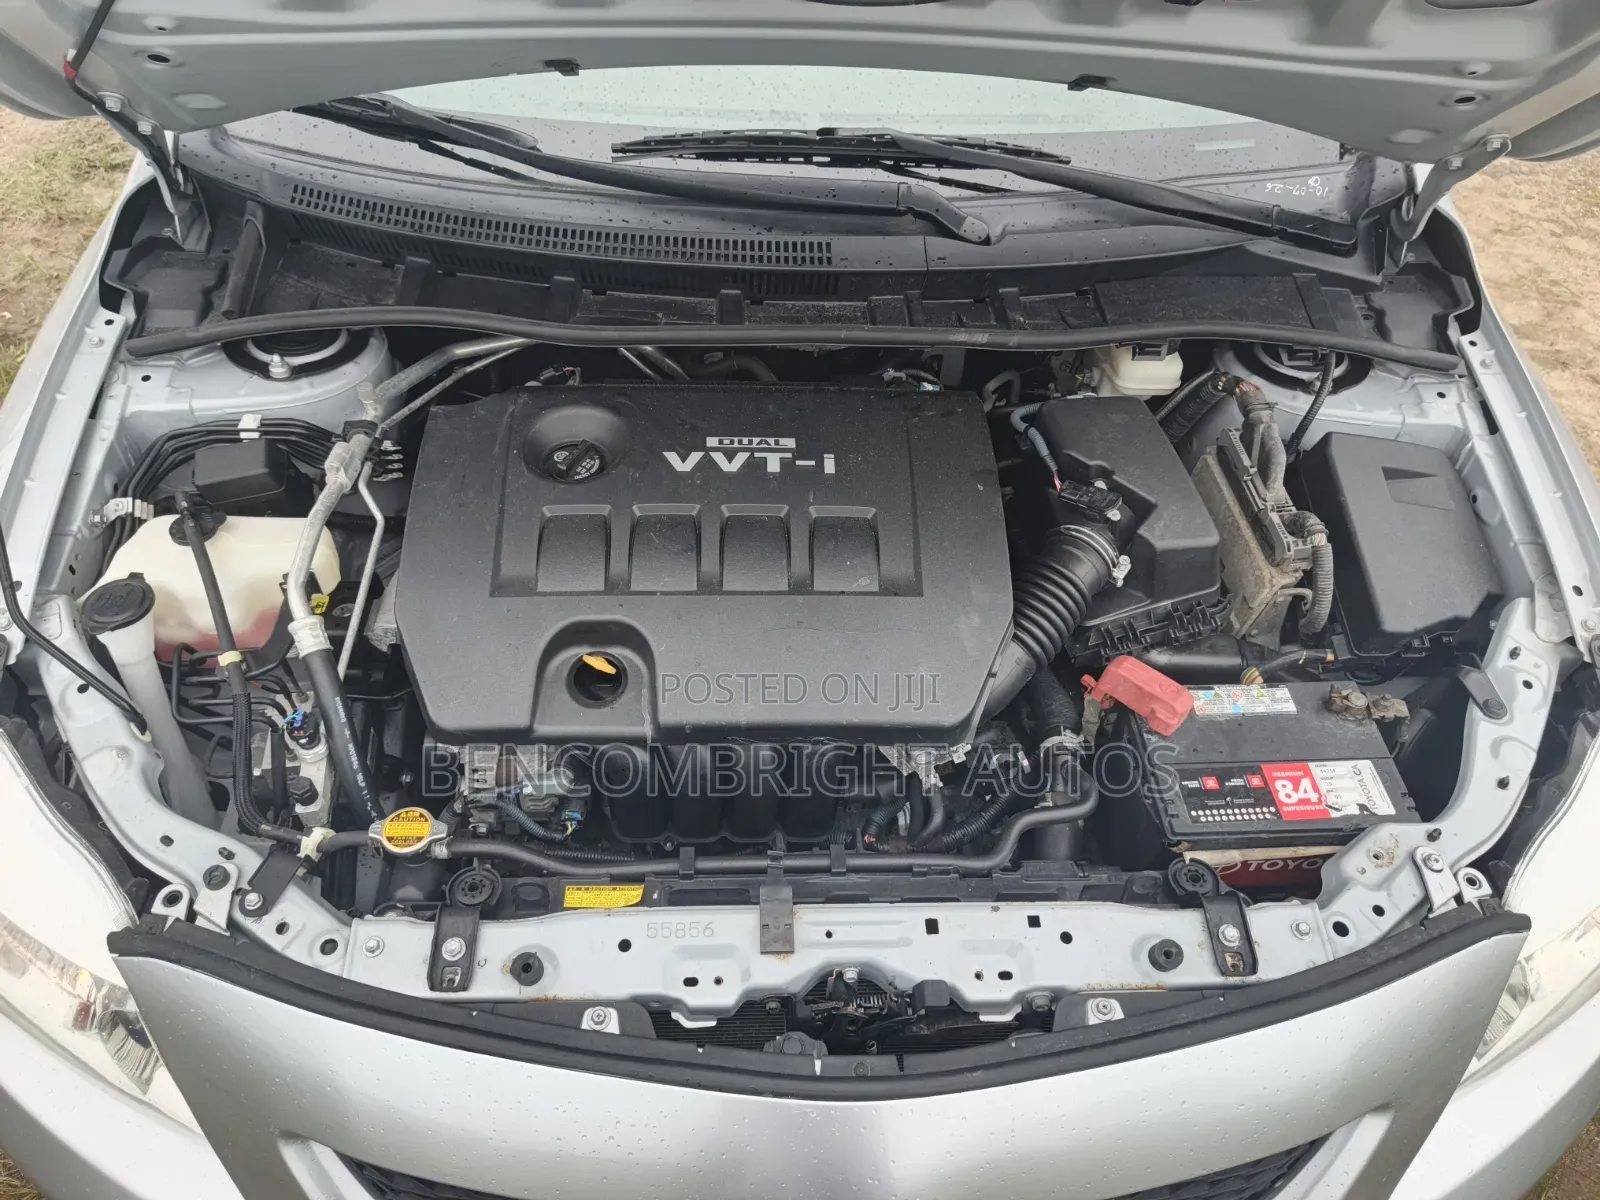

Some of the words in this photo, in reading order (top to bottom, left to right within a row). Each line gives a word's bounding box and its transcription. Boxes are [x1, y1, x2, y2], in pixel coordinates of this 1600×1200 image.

[717, 438, 789, 447] DUAL
[662, 451, 836, 474] VVT-i
[1274, 778, 1320, 804] 84
[646, 921, 714, 939] 55856
